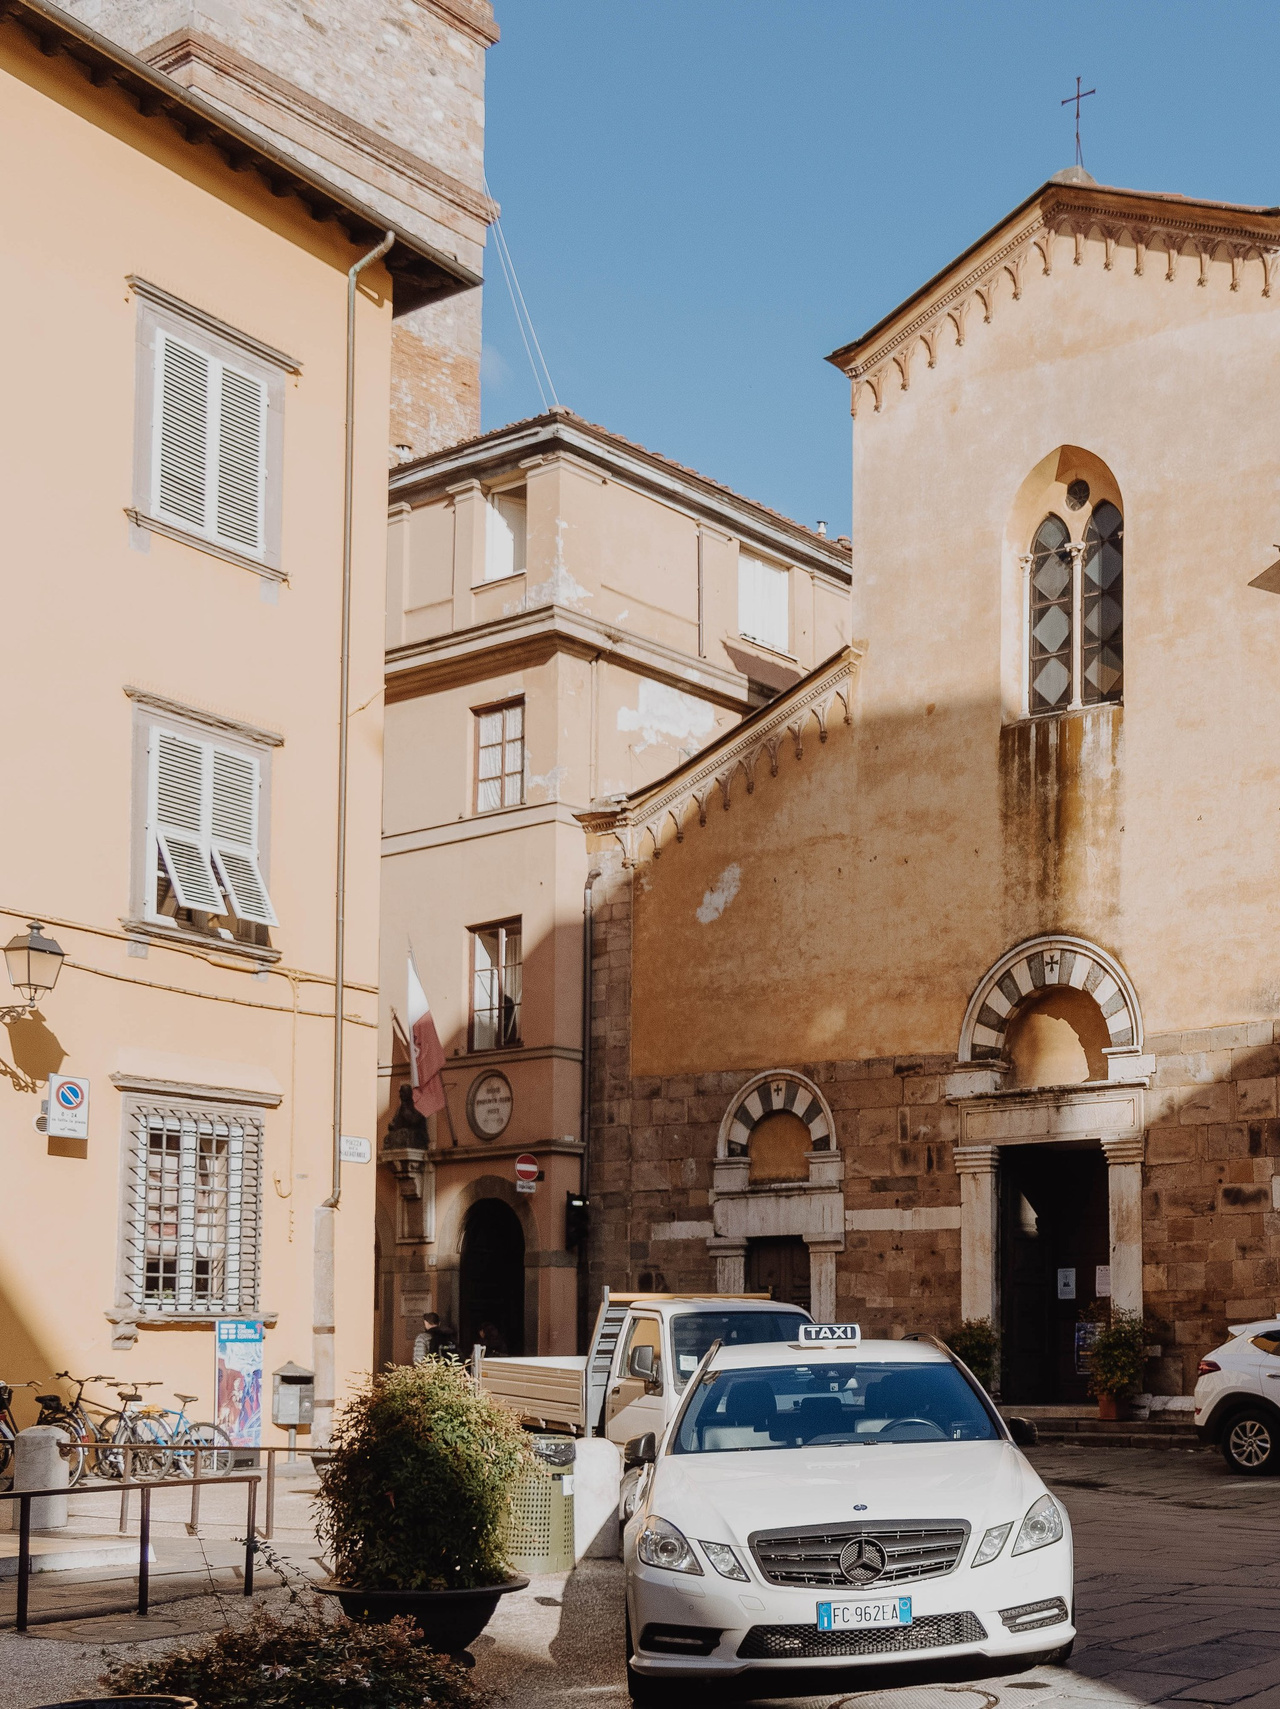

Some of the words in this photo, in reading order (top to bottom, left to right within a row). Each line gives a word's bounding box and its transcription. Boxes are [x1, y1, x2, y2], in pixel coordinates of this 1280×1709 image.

[806, 1327, 852, 1339] TAXI
[833, 1607, 850, 1623] FC
[855, 1603, 899, 1623] 962EA
